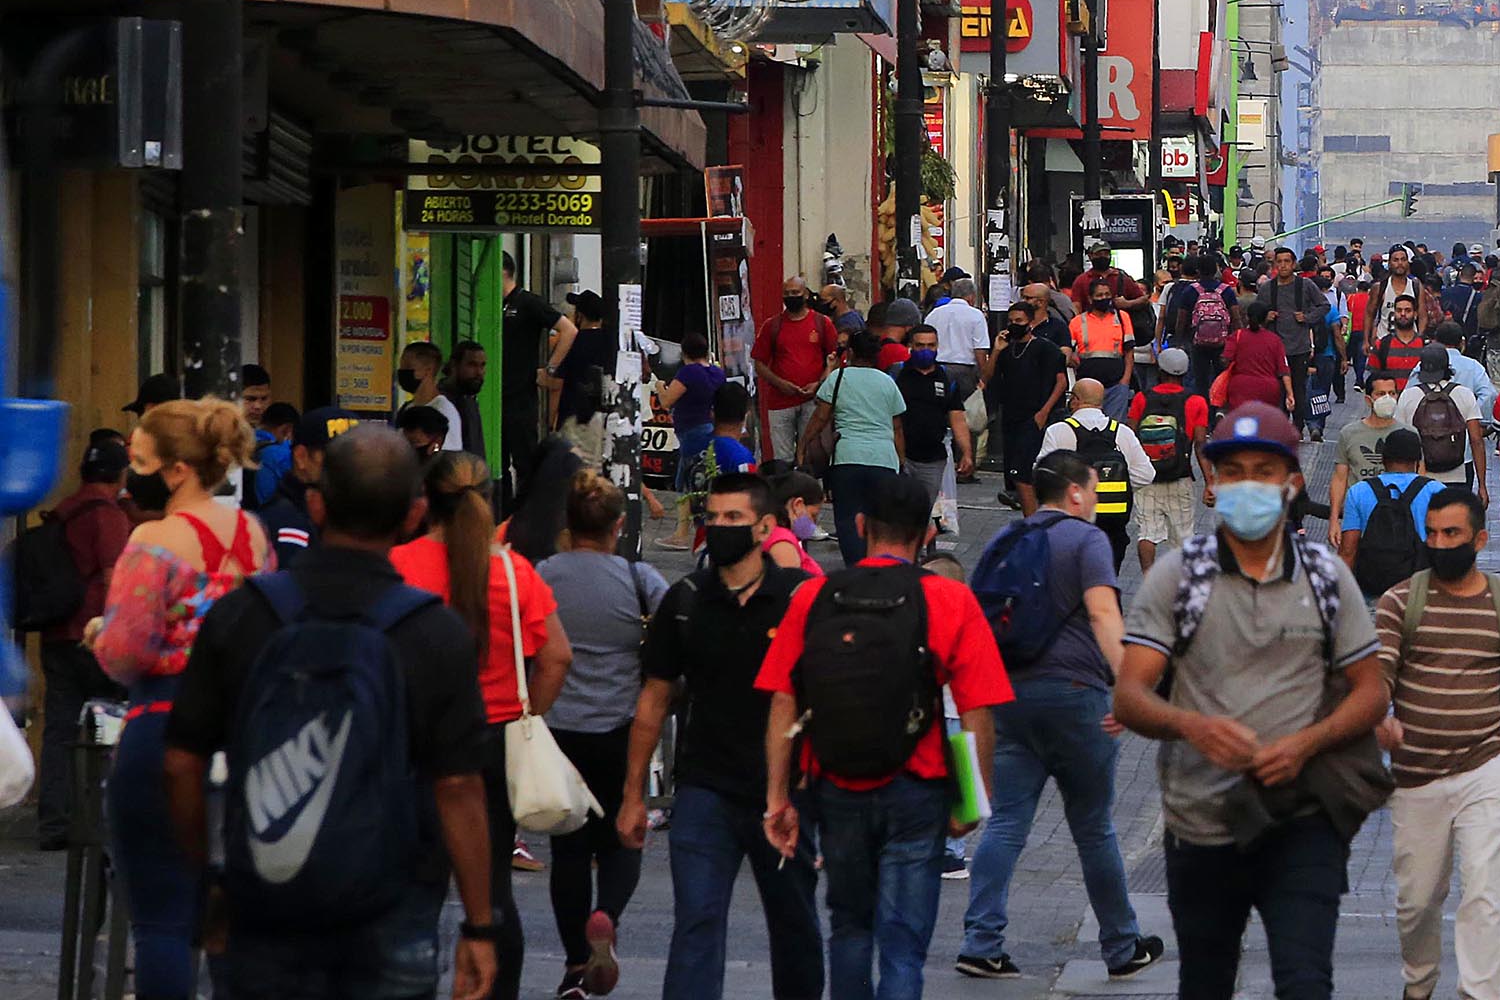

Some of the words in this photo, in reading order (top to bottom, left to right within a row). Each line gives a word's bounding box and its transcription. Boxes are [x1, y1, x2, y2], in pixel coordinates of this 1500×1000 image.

[424, 195, 472, 209] ABIERTO
[495, 193, 593, 212] 2233-5069
[421, 210, 435, 223] 24
[436, 210, 474, 223] HORAS
[511, 211, 544, 225] Hotel
[547, 212, 593, 226] Dorado
[1116, 217, 1138, 228] JOSE
[245, 710, 332, 835] NIKE
